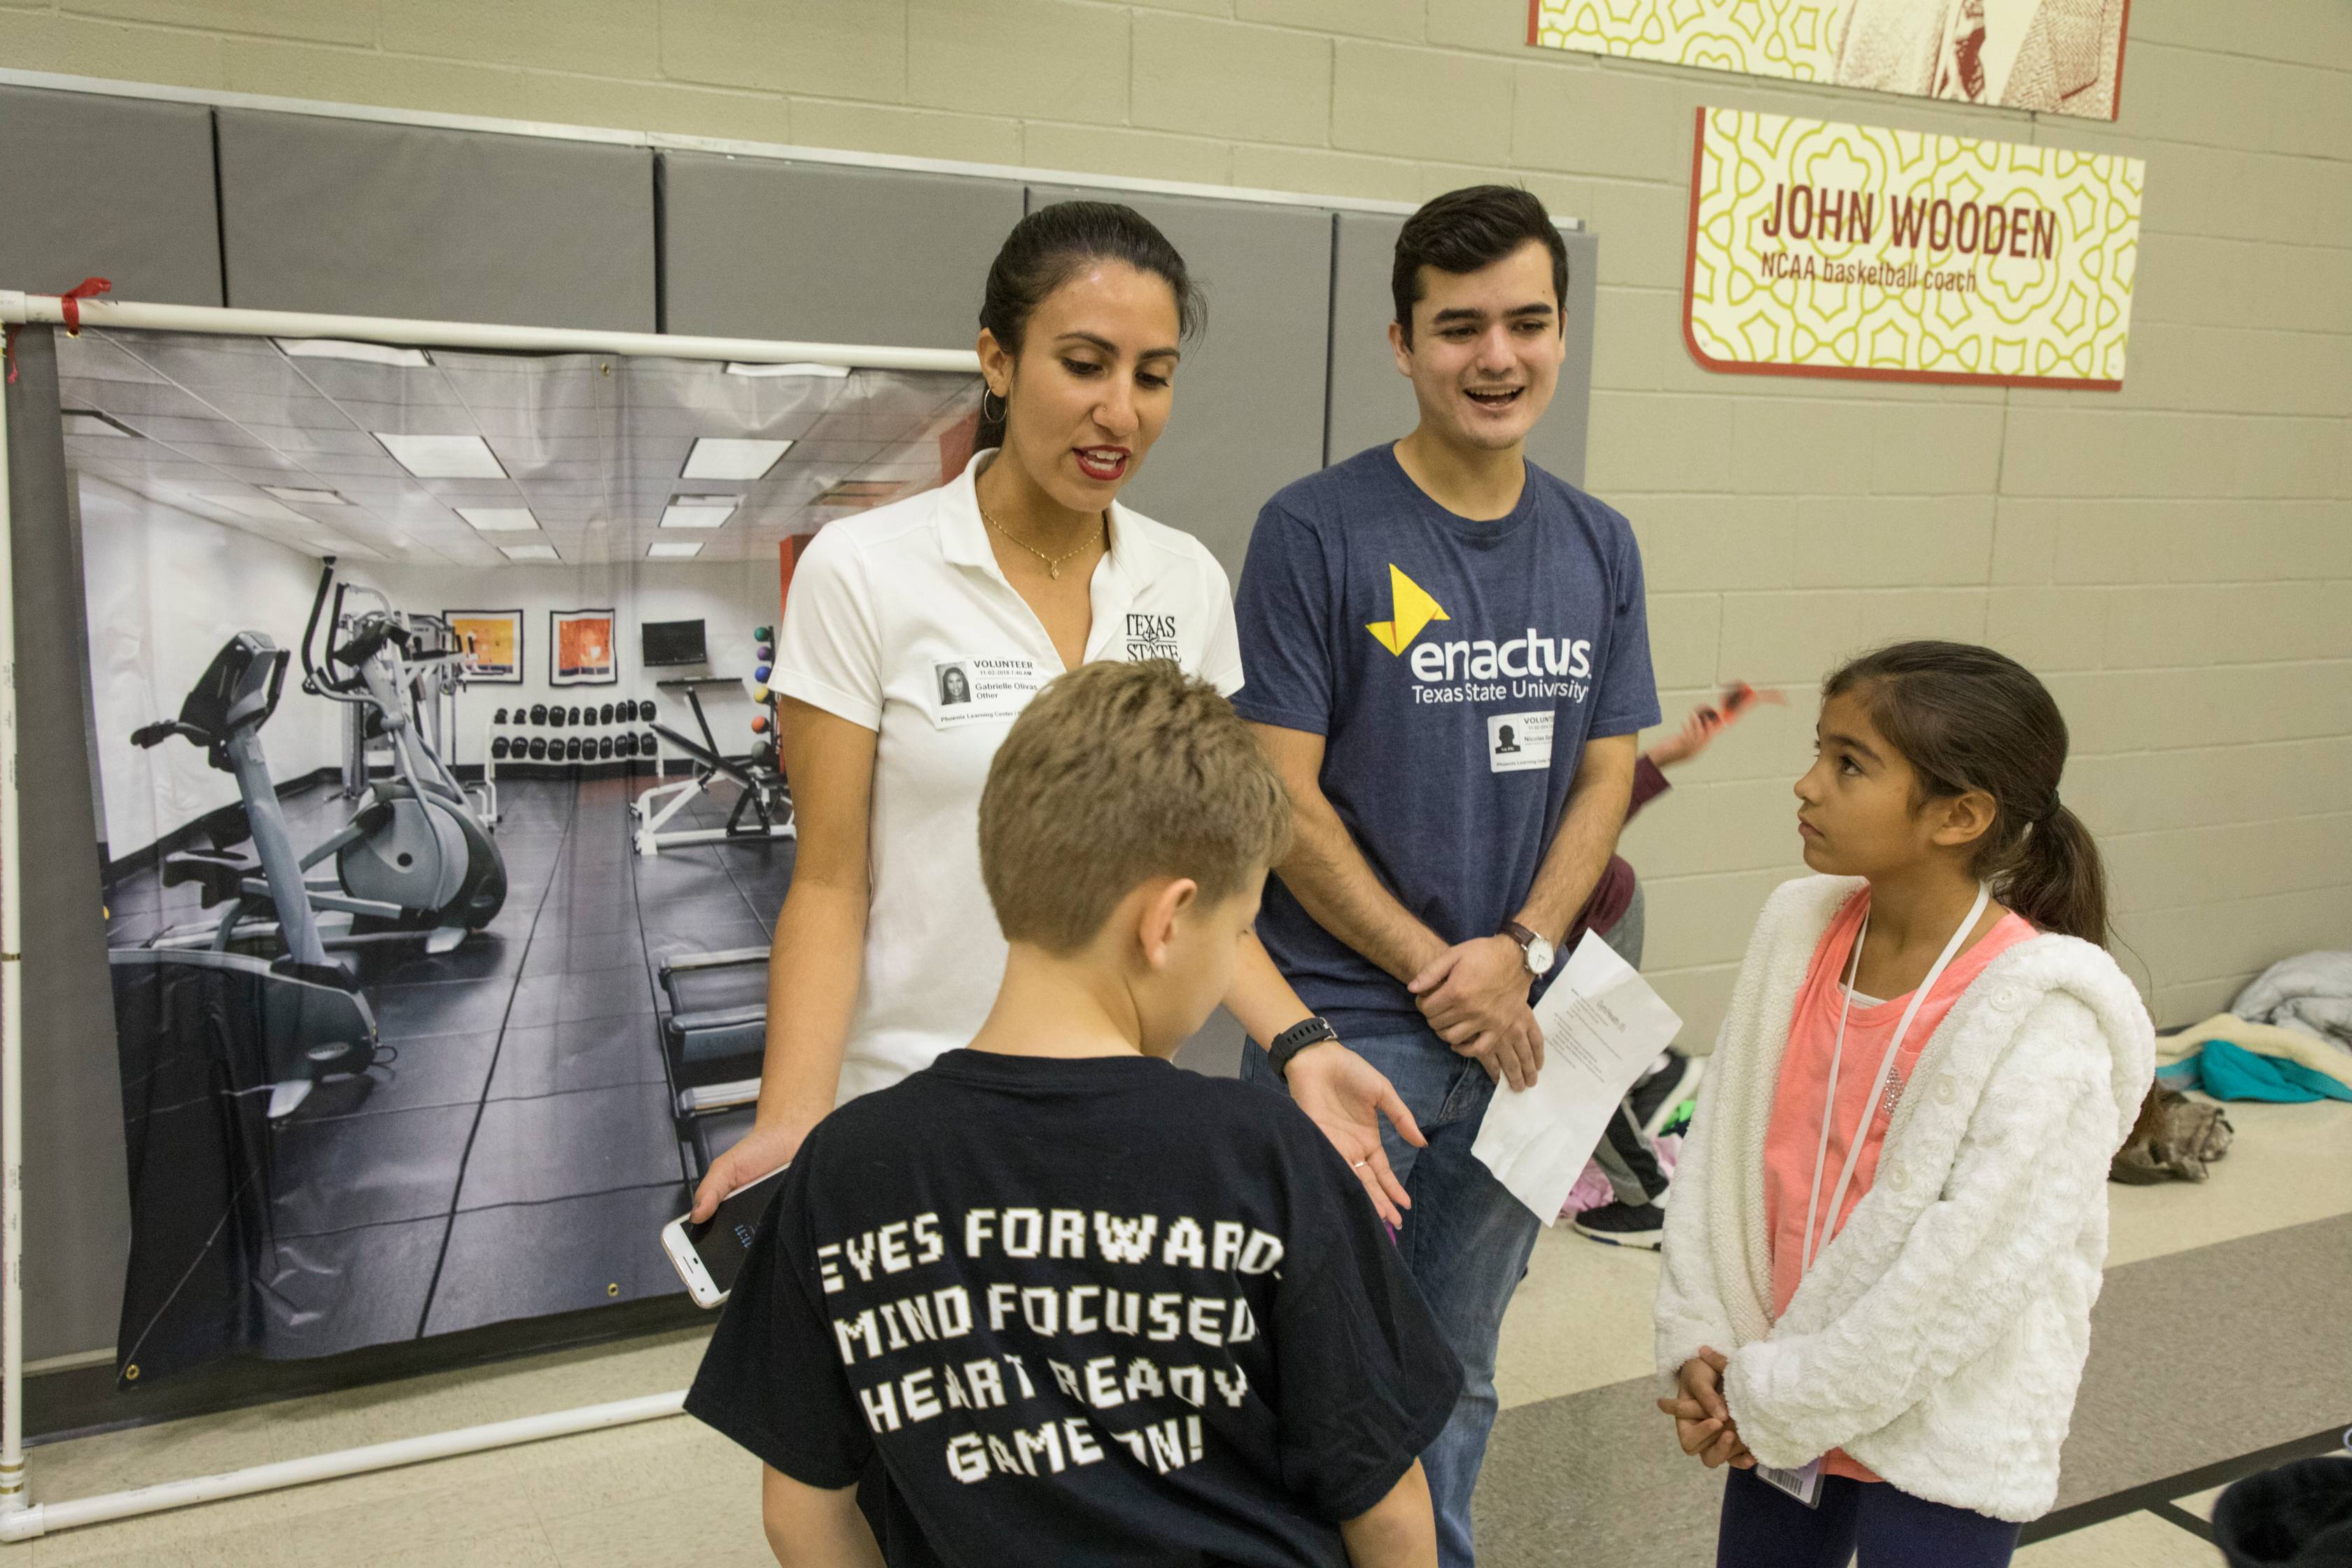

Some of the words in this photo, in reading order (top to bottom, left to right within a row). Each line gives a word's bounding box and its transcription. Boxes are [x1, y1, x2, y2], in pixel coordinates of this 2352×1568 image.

[1763, 183, 1874, 244] JOHN
[1891, 193, 2057, 260] WOODEN
[1762, 253, 1816, 281] NCAA
[1823, 256, 1918, 290] basketball
[1924, 268, 1977, 293] coach
[1126, 614, 1176, 638] TEXAS
[974, 660, 1033, 668] VOLUNTEER
[1126, 643, 1182, 663] STATE
[975, 682, 1012, 691] Gabrielle
[1412, 685, 1464, 704] Texas
[1465, 682, 1507, 702] State
[1512, 679, 1590, 704] Univrsity
[817, 1212, 945, 1294] EYES
[832, 1284, 974, 1365] MIND
[986, 1282, 1256, 1348] FOCUSED
[859, 1352, 1035, 1434] HEART
[1047, 1354, 1249, 1409] READY
[946, 1416, 1105, 1485] GAME
